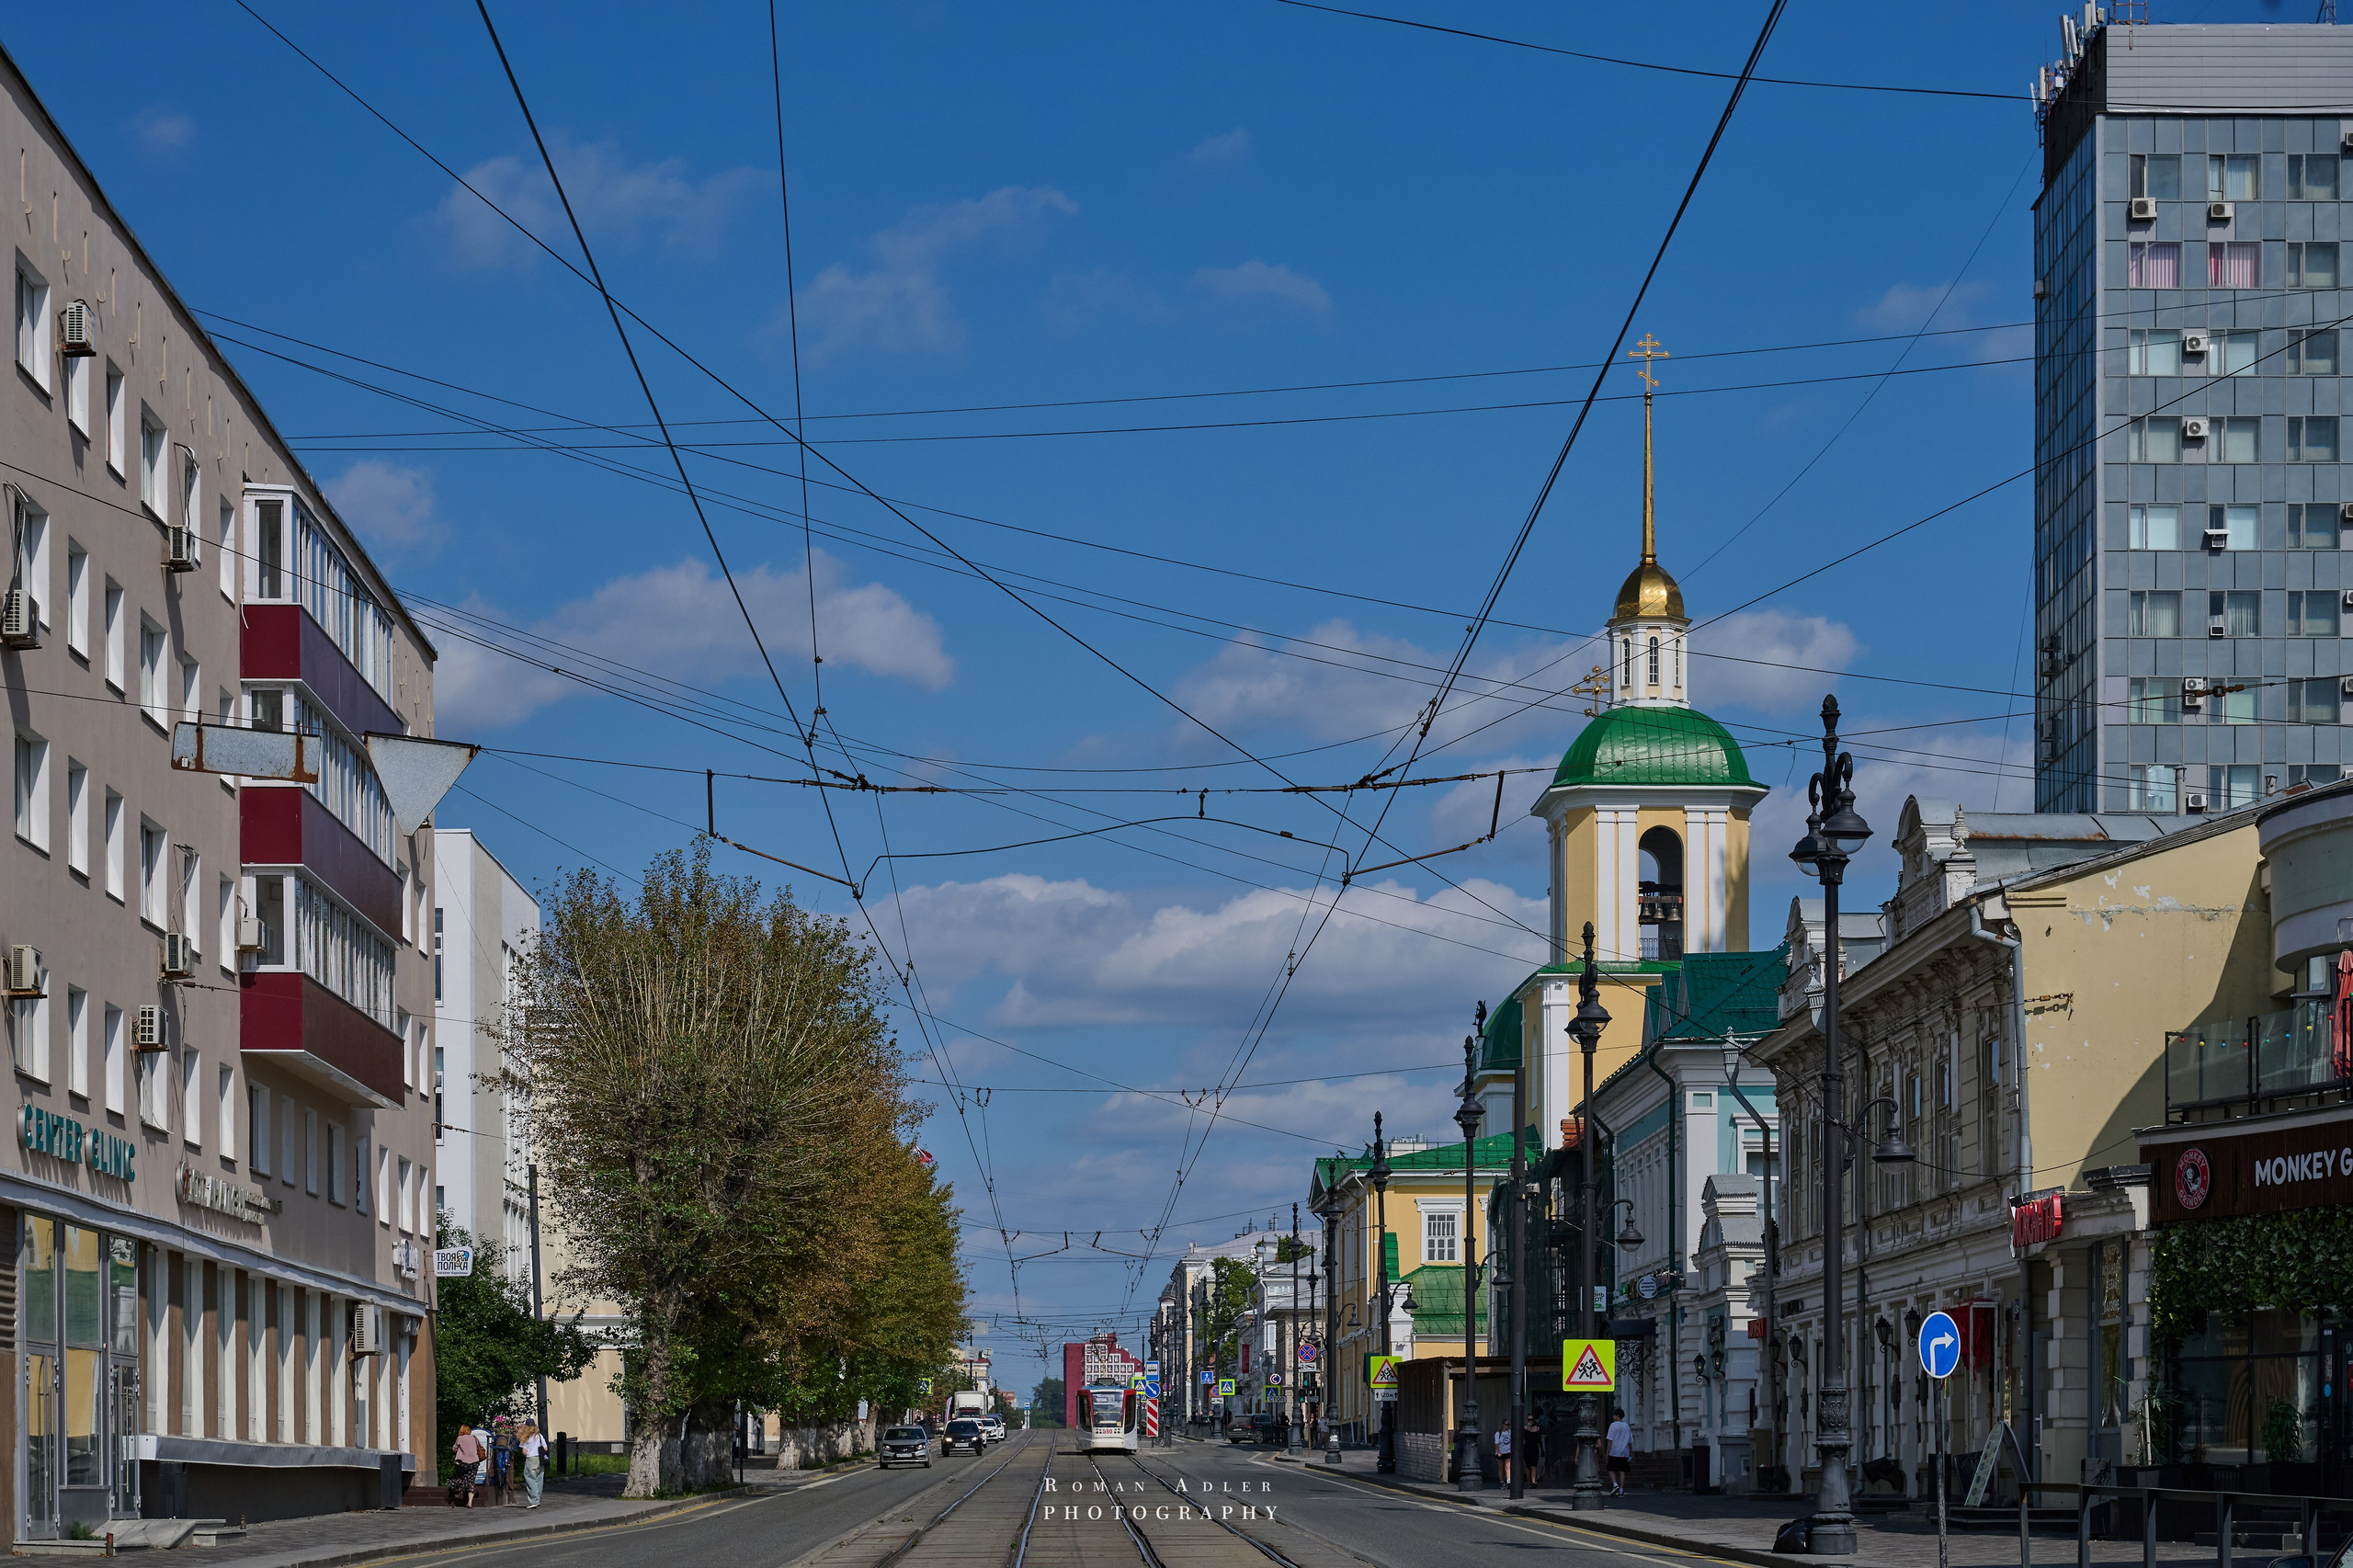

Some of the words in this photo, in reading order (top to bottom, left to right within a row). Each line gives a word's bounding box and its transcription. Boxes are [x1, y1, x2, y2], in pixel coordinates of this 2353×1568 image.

[24, 1103, 83, 1164] CENTER
[91, 1128, 135, 1182] CLINIC
[2178, 1151, 2206, 1170] MONKEY
[2255, 1149, 2336, 1187] MONKEY
[2178, 1187, 2206, 1207] GRINDER
[437, 1253, 456, 1261] ТВОЯ
[437, 1262, 468, 1270] ПОЛКА
